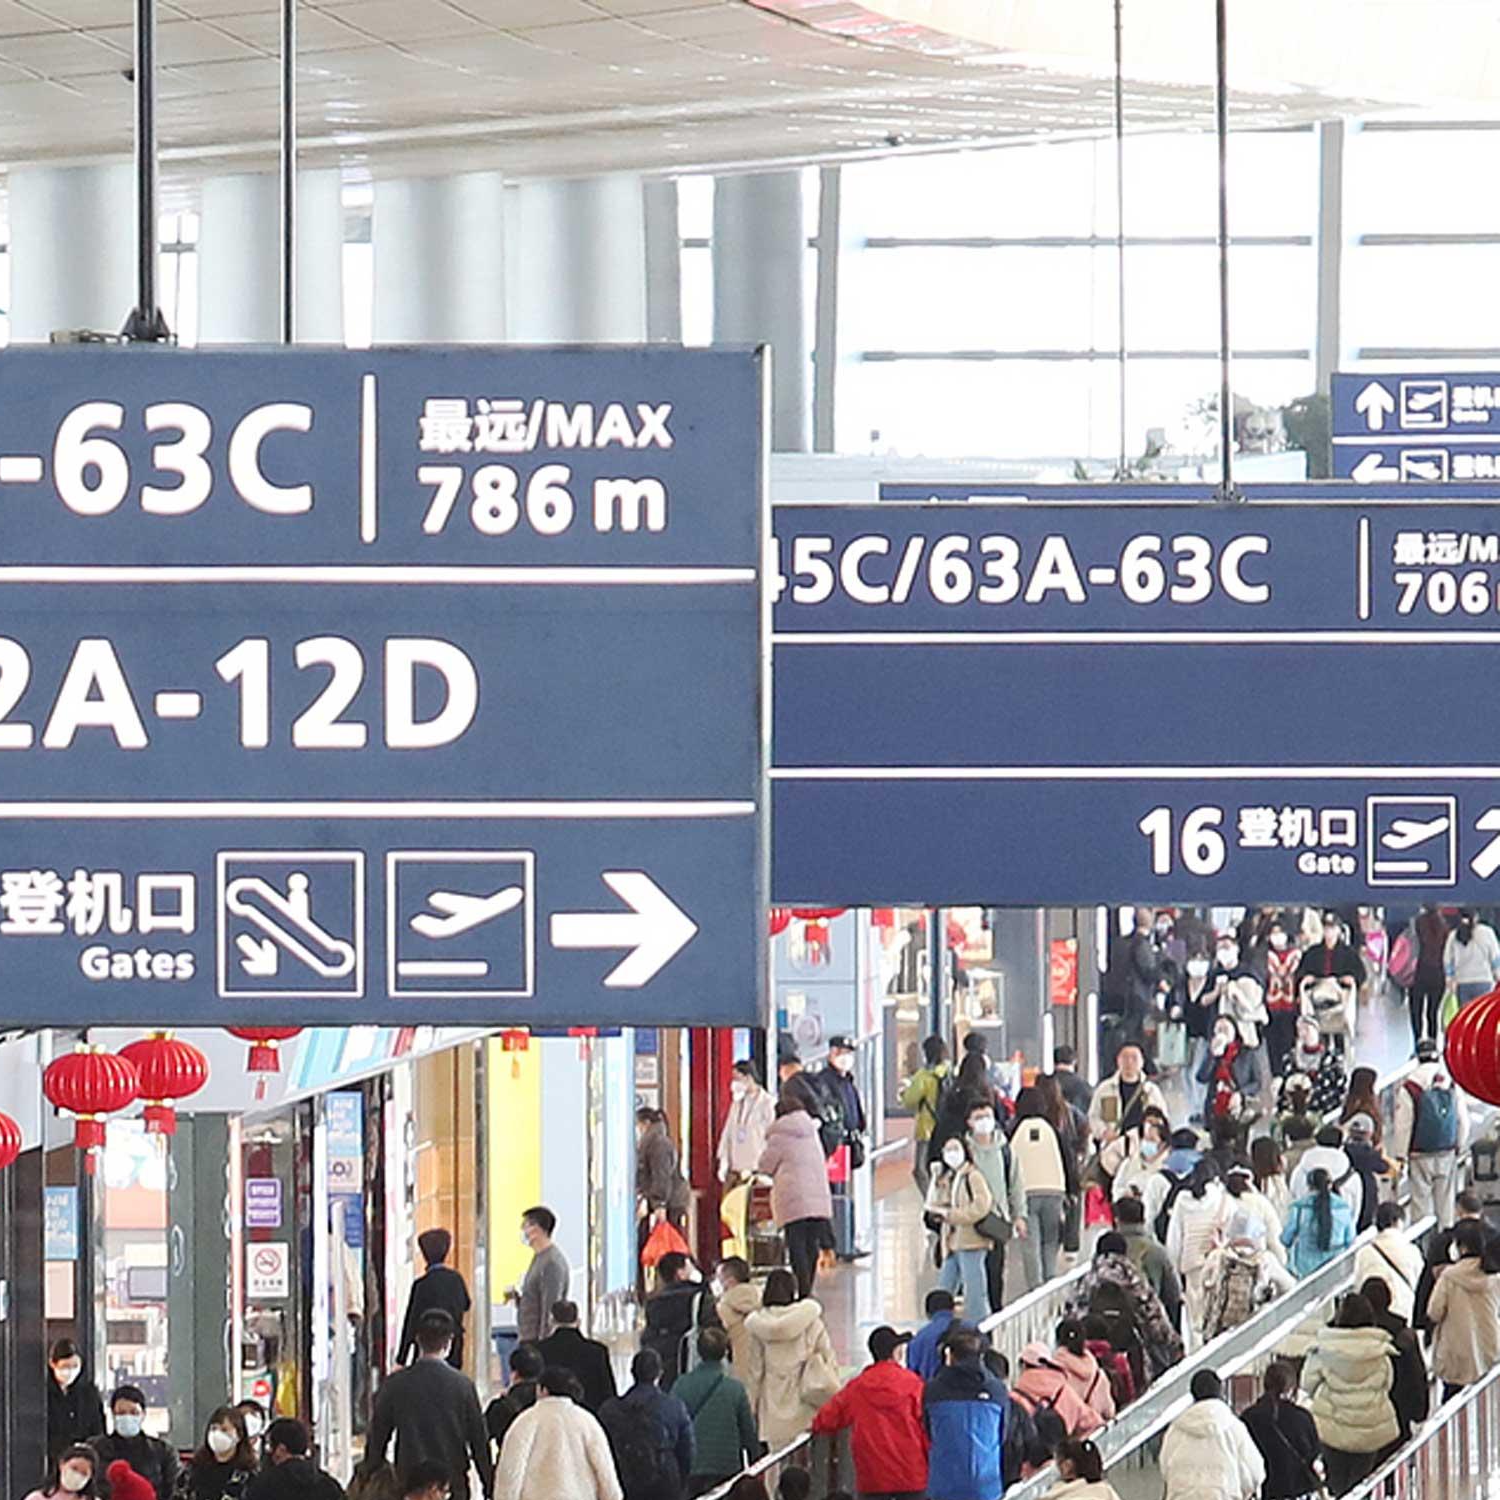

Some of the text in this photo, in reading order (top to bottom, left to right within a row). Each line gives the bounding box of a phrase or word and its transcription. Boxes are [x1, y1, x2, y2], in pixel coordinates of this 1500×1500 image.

[419, 399, 673, 453] 最远/MAX
[418, 465, 666, 534] 786 m
[1393, 532, 1500, 566] 最远/M
[1395, 570, 1489, 614] 706
[1141, 807, 1225, 875] 16
[1238, 806, 1356, 848] 登机口
[1298, 852, 1356, 874] Gate
[81, 946, 194, 979] Gates
